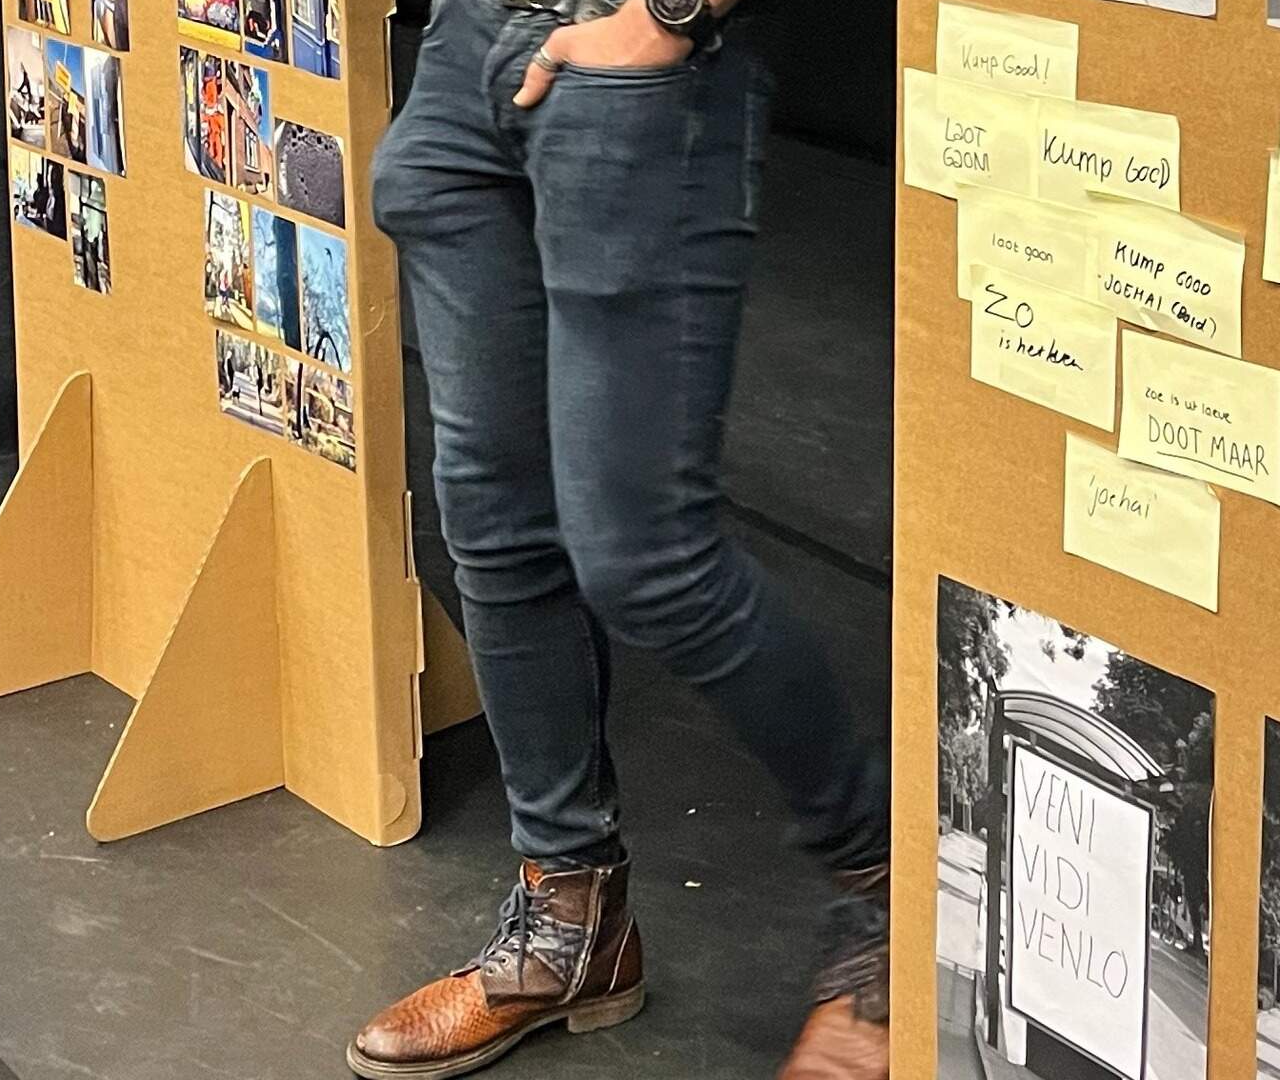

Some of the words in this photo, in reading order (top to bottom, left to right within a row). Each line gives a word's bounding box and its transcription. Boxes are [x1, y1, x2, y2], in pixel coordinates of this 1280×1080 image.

[1148, 414, 1201, 455] DOOT
[1210, 436, 1270, 477] MAAR
[1019, 758, 1096, 855] VENI
[1017, 836, 1090, 919] VIDI
[1018, 900, 1128, 1000] VENLO
